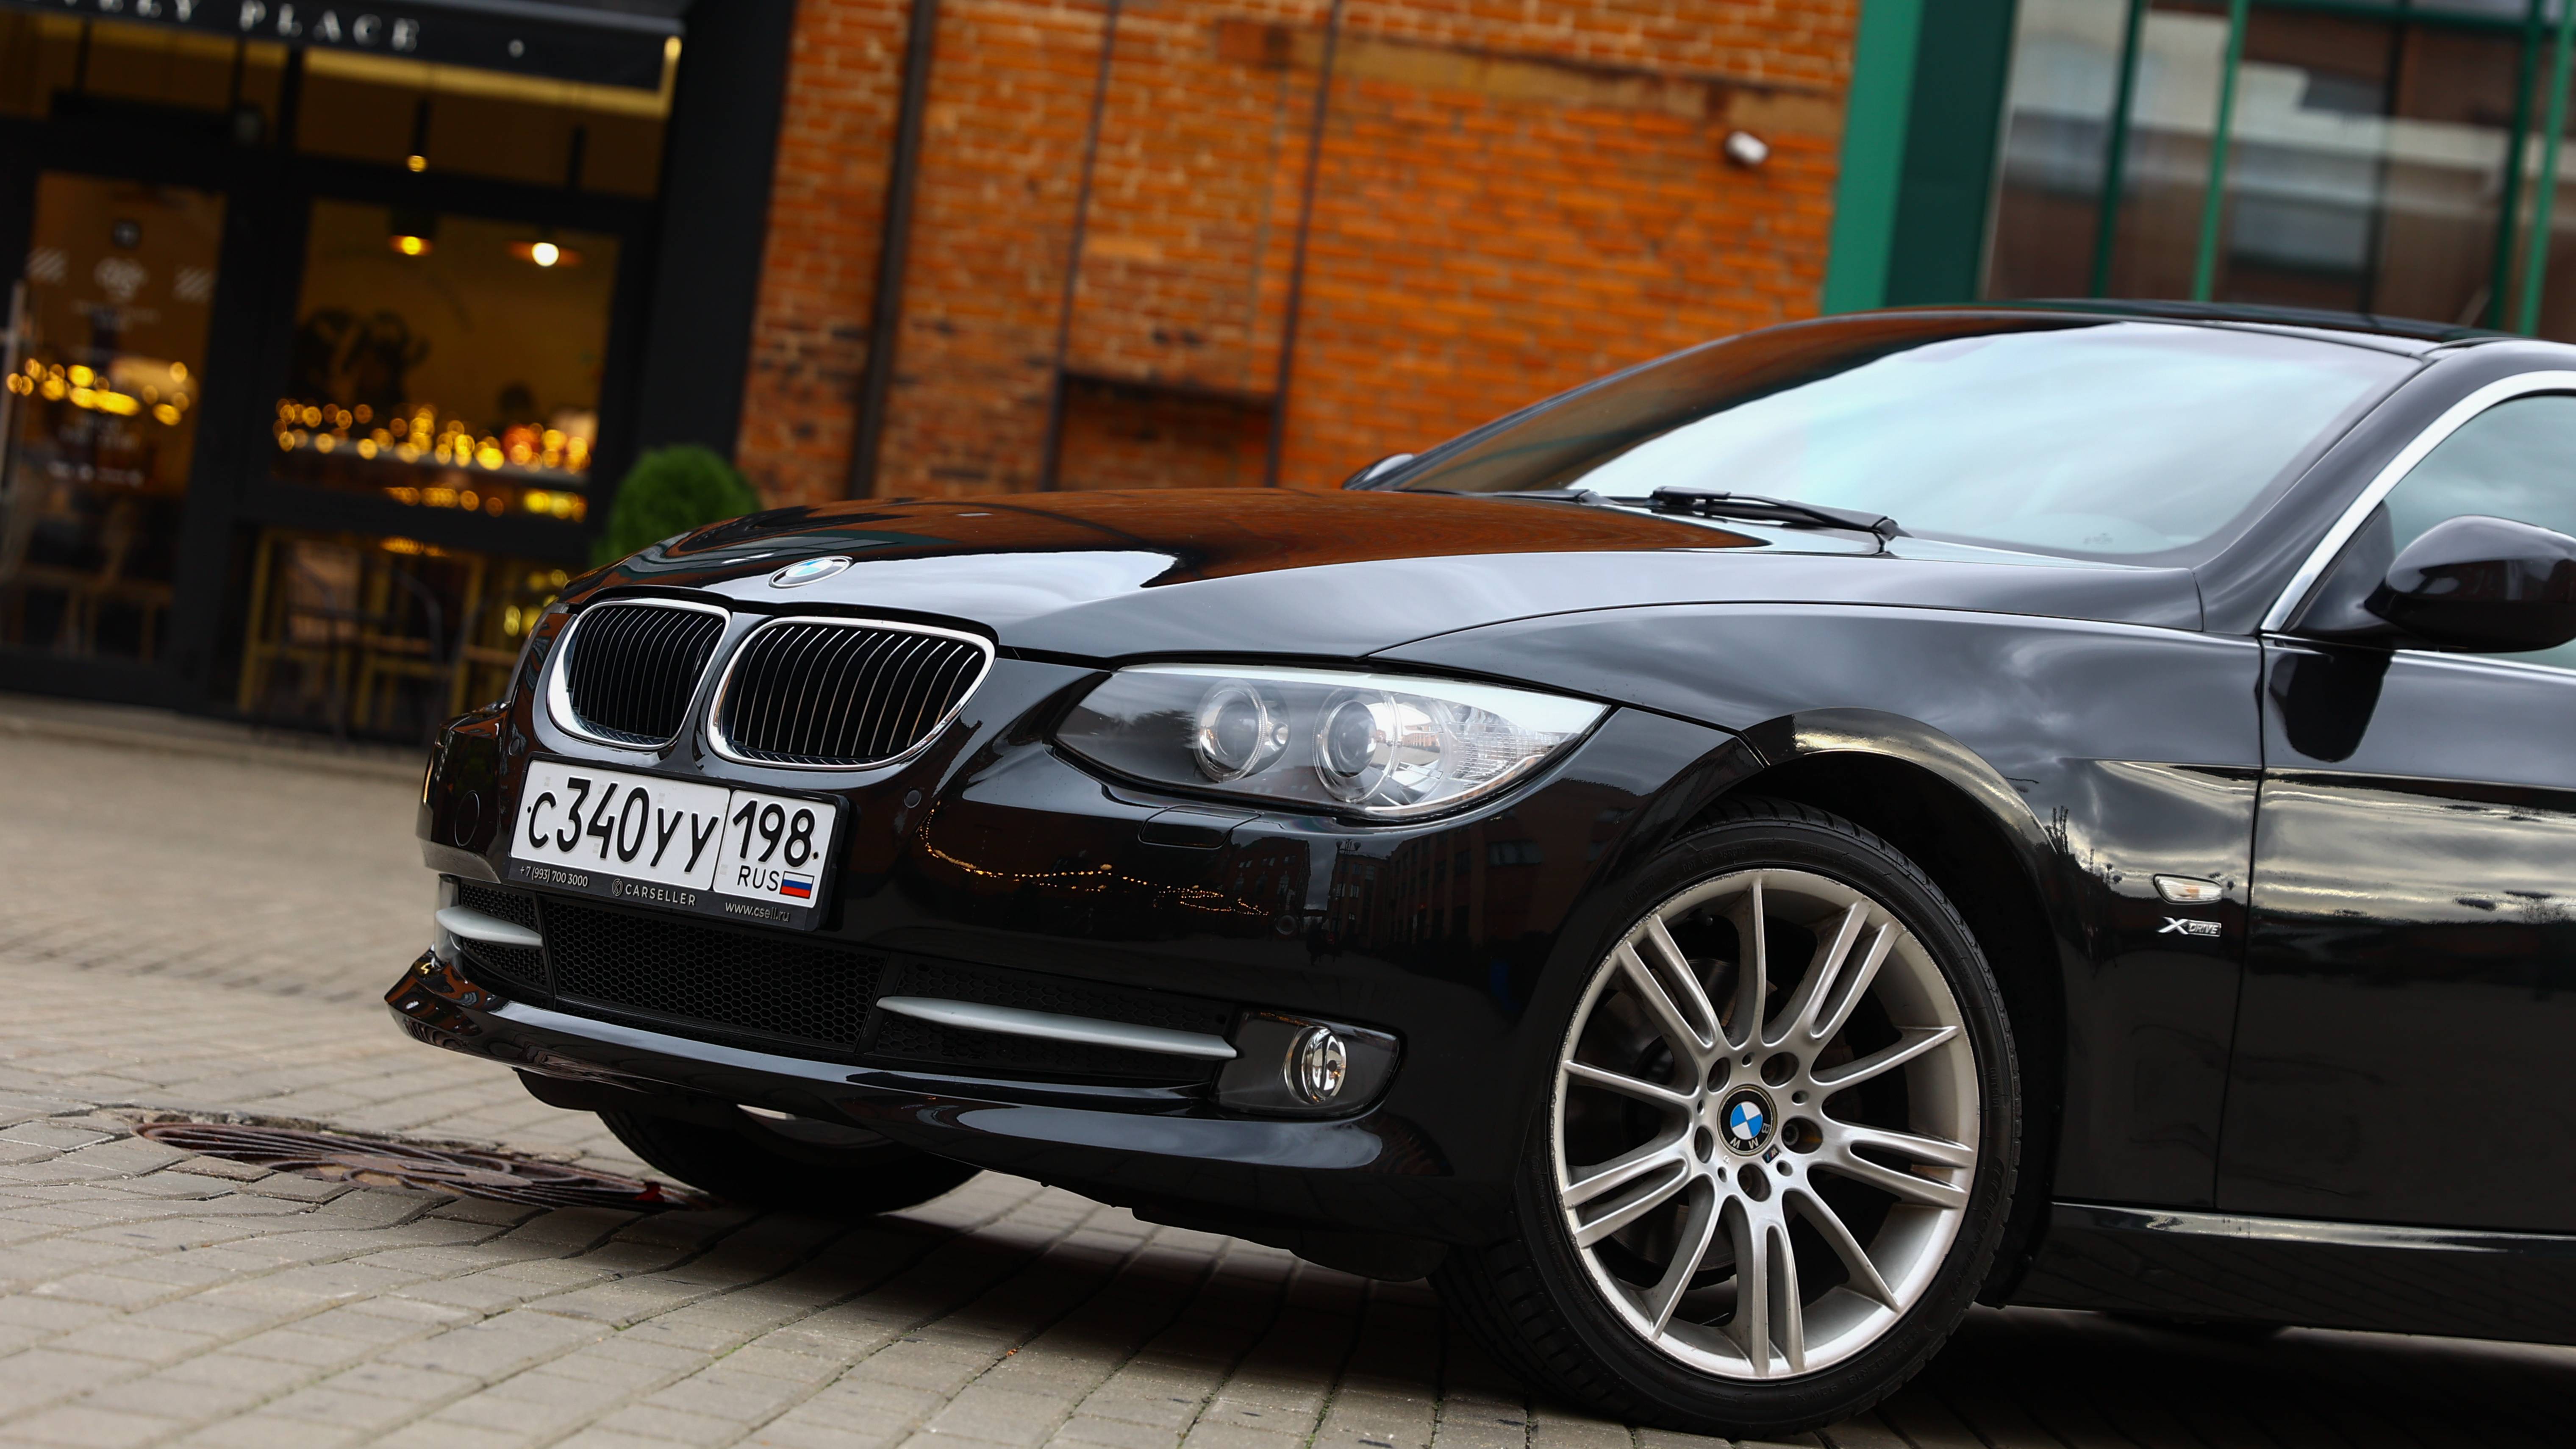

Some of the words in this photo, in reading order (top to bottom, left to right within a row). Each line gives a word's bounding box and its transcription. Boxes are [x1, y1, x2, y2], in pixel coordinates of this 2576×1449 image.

[239, 0, 420, 52] PLACE
[732, 800, 816, 868] 198
[532, 866, 550, 883] (993)
[552, 870, 566, 883] 700
[567, 873, 588, 887] 3000
[737, 865, 780, 891] RUS
[625, 884, 696, 906] CARSELLER
[725, 902, 790, 922] www.csell.ru
[1729, 1122, 1771, 1149] BMW
